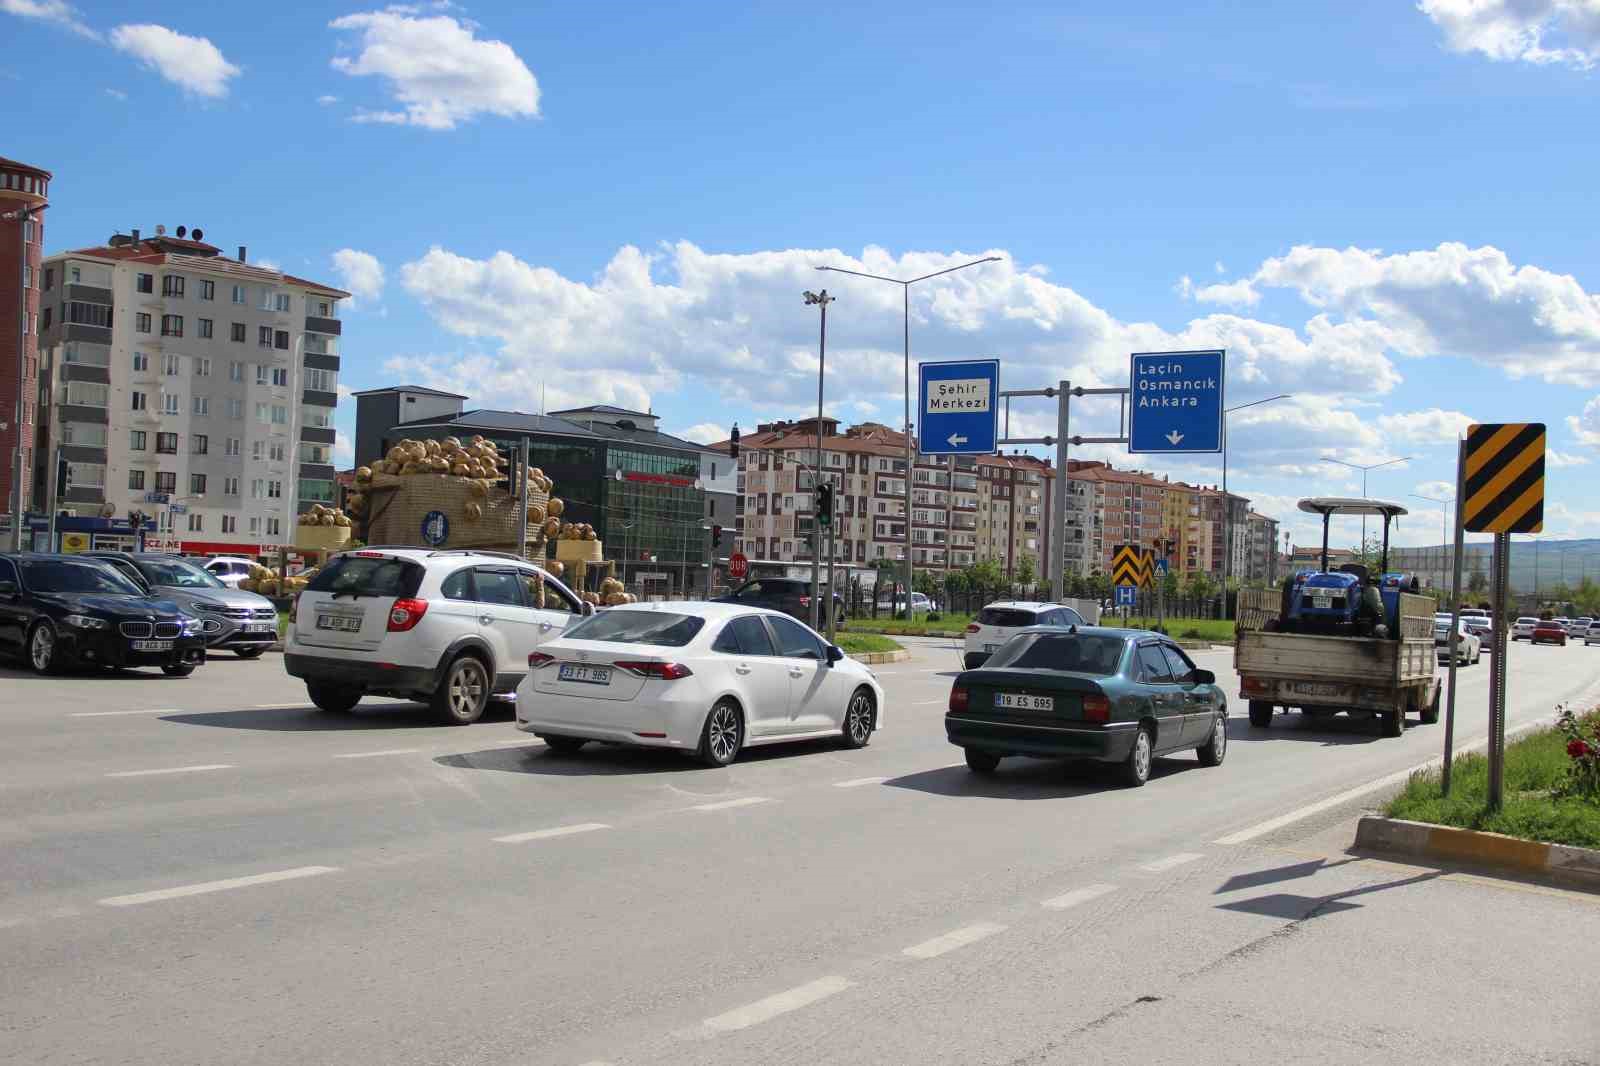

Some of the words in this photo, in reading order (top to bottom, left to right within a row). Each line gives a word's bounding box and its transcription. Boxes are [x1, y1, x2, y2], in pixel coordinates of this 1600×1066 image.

[1139, 362, 1183, 375] Laçin
[938, 383, 977, 396] Şehir
[1139, 377, 1216, 391] Osmancık
[930, 397, 987, 409] Merkezi
[1139, 396, 1198, 408] Ankara
[144, 539, 180, 549] ECZNE
[1120, 588, 1132, 603] H
[1017, 696, 1028, 707] ES
